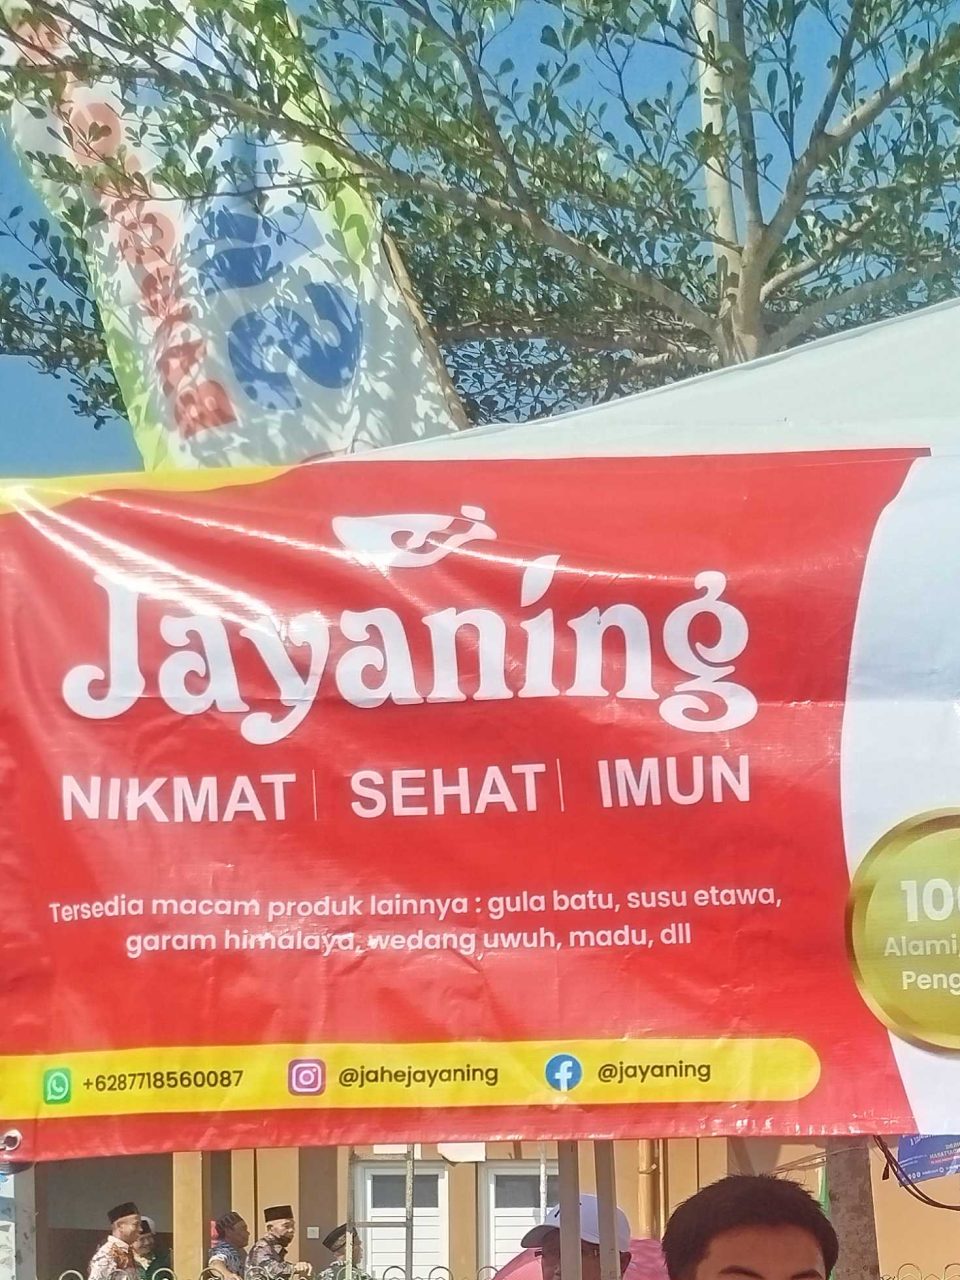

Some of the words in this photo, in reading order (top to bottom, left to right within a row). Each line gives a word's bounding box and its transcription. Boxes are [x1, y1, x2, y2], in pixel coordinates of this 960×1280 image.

[62, 555, 758, 745] Jayaning
[62, 774, 297, 823] NIKMAT
[349, 763, 547, 820] SEHAT
[598, 755, 752, 808] IMUN
[49, 893, 144, 924] Tersedia
[152, 899, 261, 918] macam
[267, 895, 363, 923] produk
[370, 893, 469, 921] lainnya
[488, 890, 546, 922] gula
[552, 888, 622, 917] batu,
[627, 890, 688, 911] susu
[694, 885, 783, 912] etawa,
[126, 936, 217, 963] garam
[223, 925, 363, 958] himalaya,
[367, 926, 476, 958] wedang
[483, 924, 565, 955] uwuh,
[569, 922, 655, 951] madu,
[660, 918, 692, 946] dll
[83, 1070, 243, 1091] +6287718560087
[338, 1062, 499, 1090] @jahejayaning
[597, 1058, 712, 1086] @jayaning
